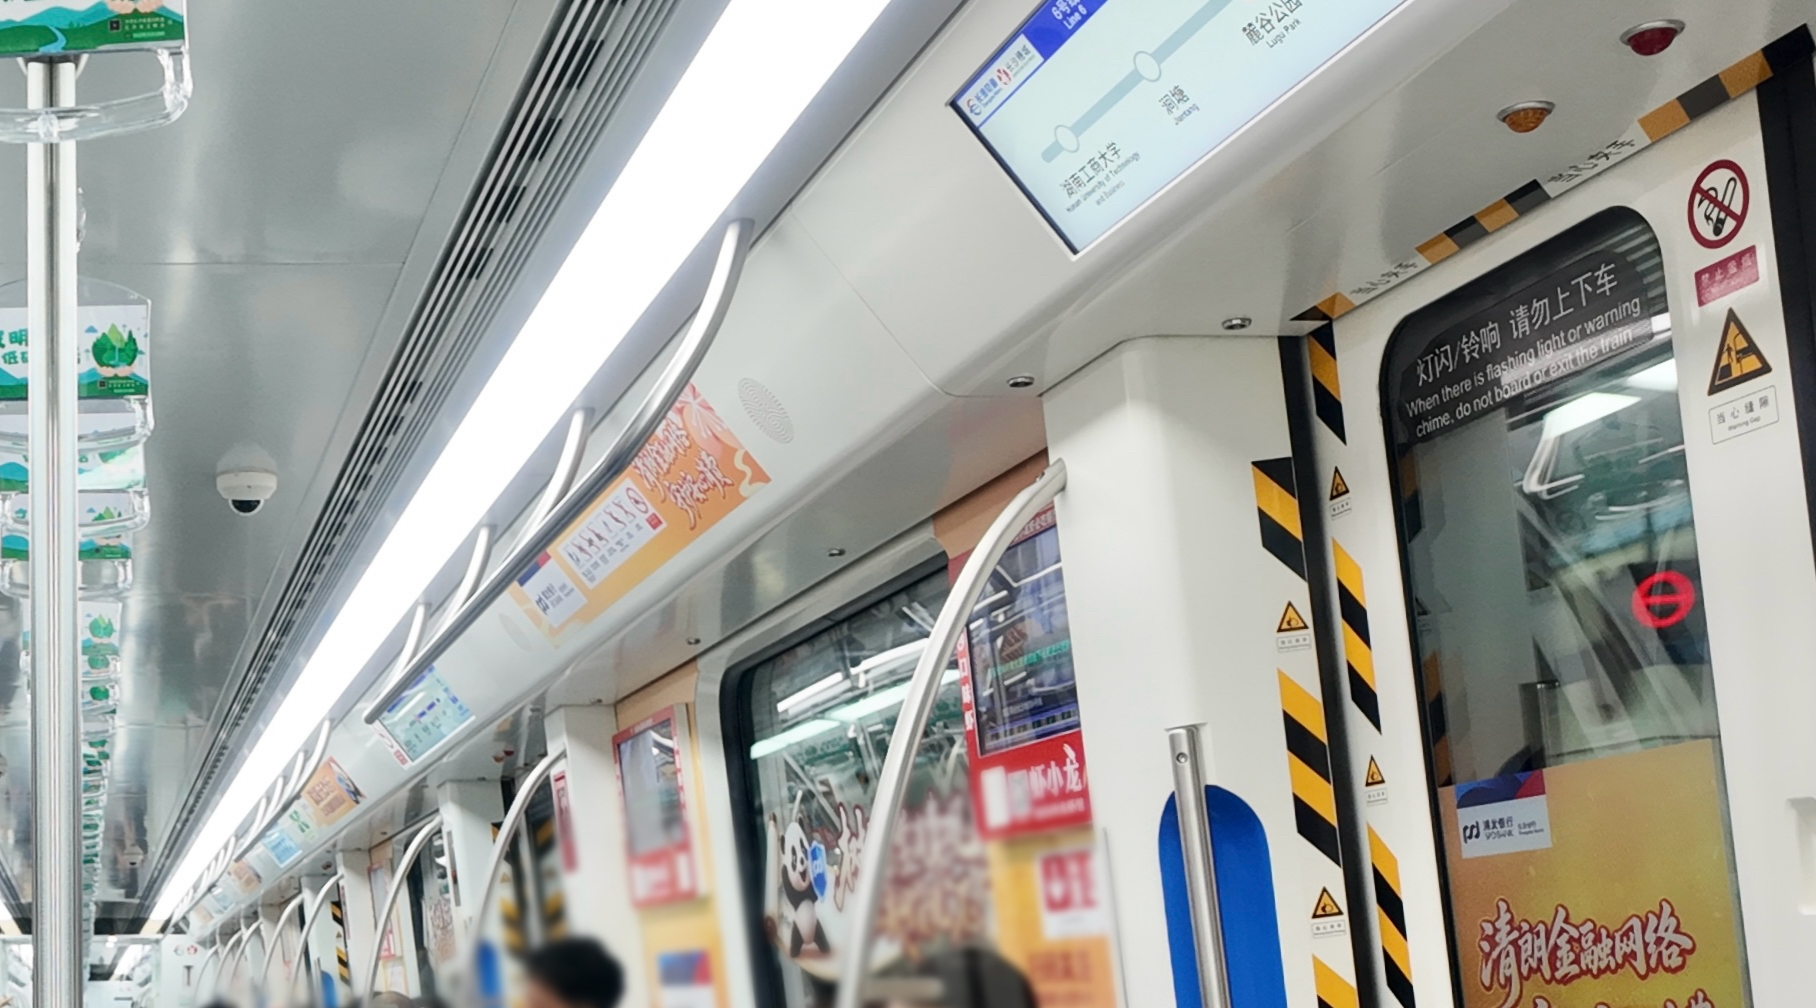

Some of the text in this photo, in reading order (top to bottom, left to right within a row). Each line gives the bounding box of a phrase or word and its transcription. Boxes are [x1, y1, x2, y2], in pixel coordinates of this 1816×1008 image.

[1063, 4, 1087, 29] Line 6
[1266, 18, 1301, 48] Lugu Park
[1060, 141, 1121, 198] 湖南工商大学
[1407, 297, 1641, 418] When there is flashing light or warning
[1416, 262, 1618, 387] 灯闪/铃响 请勿上下车
[1416, 327, 1633, 438] chime, do not board or exit the train
